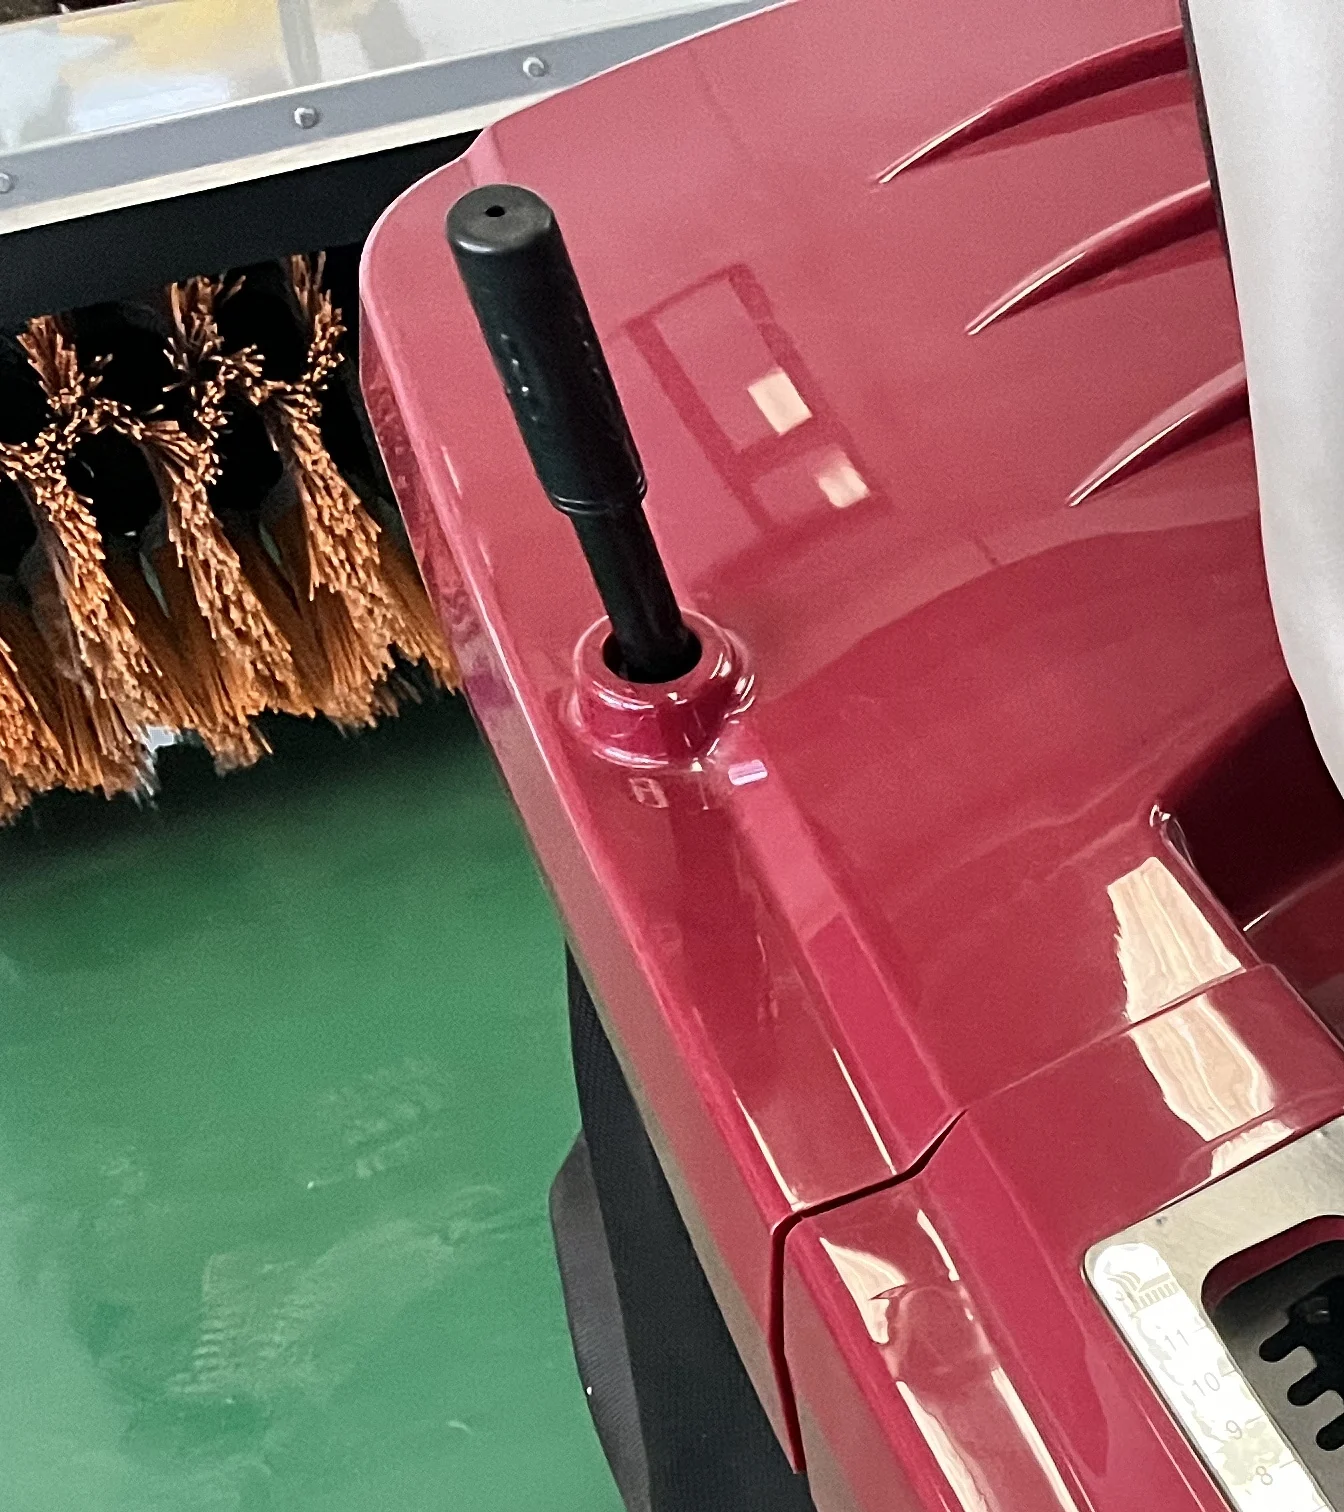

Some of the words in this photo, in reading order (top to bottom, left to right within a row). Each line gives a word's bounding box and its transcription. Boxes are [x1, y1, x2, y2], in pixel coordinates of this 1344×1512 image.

[1164, 1329, 1190, 1352] 11
[1191, 1371, 1221, 1397] 10
[1225, 1419, 1242, 1440] 9
[1255, 1465, 1274, 1486] 8
